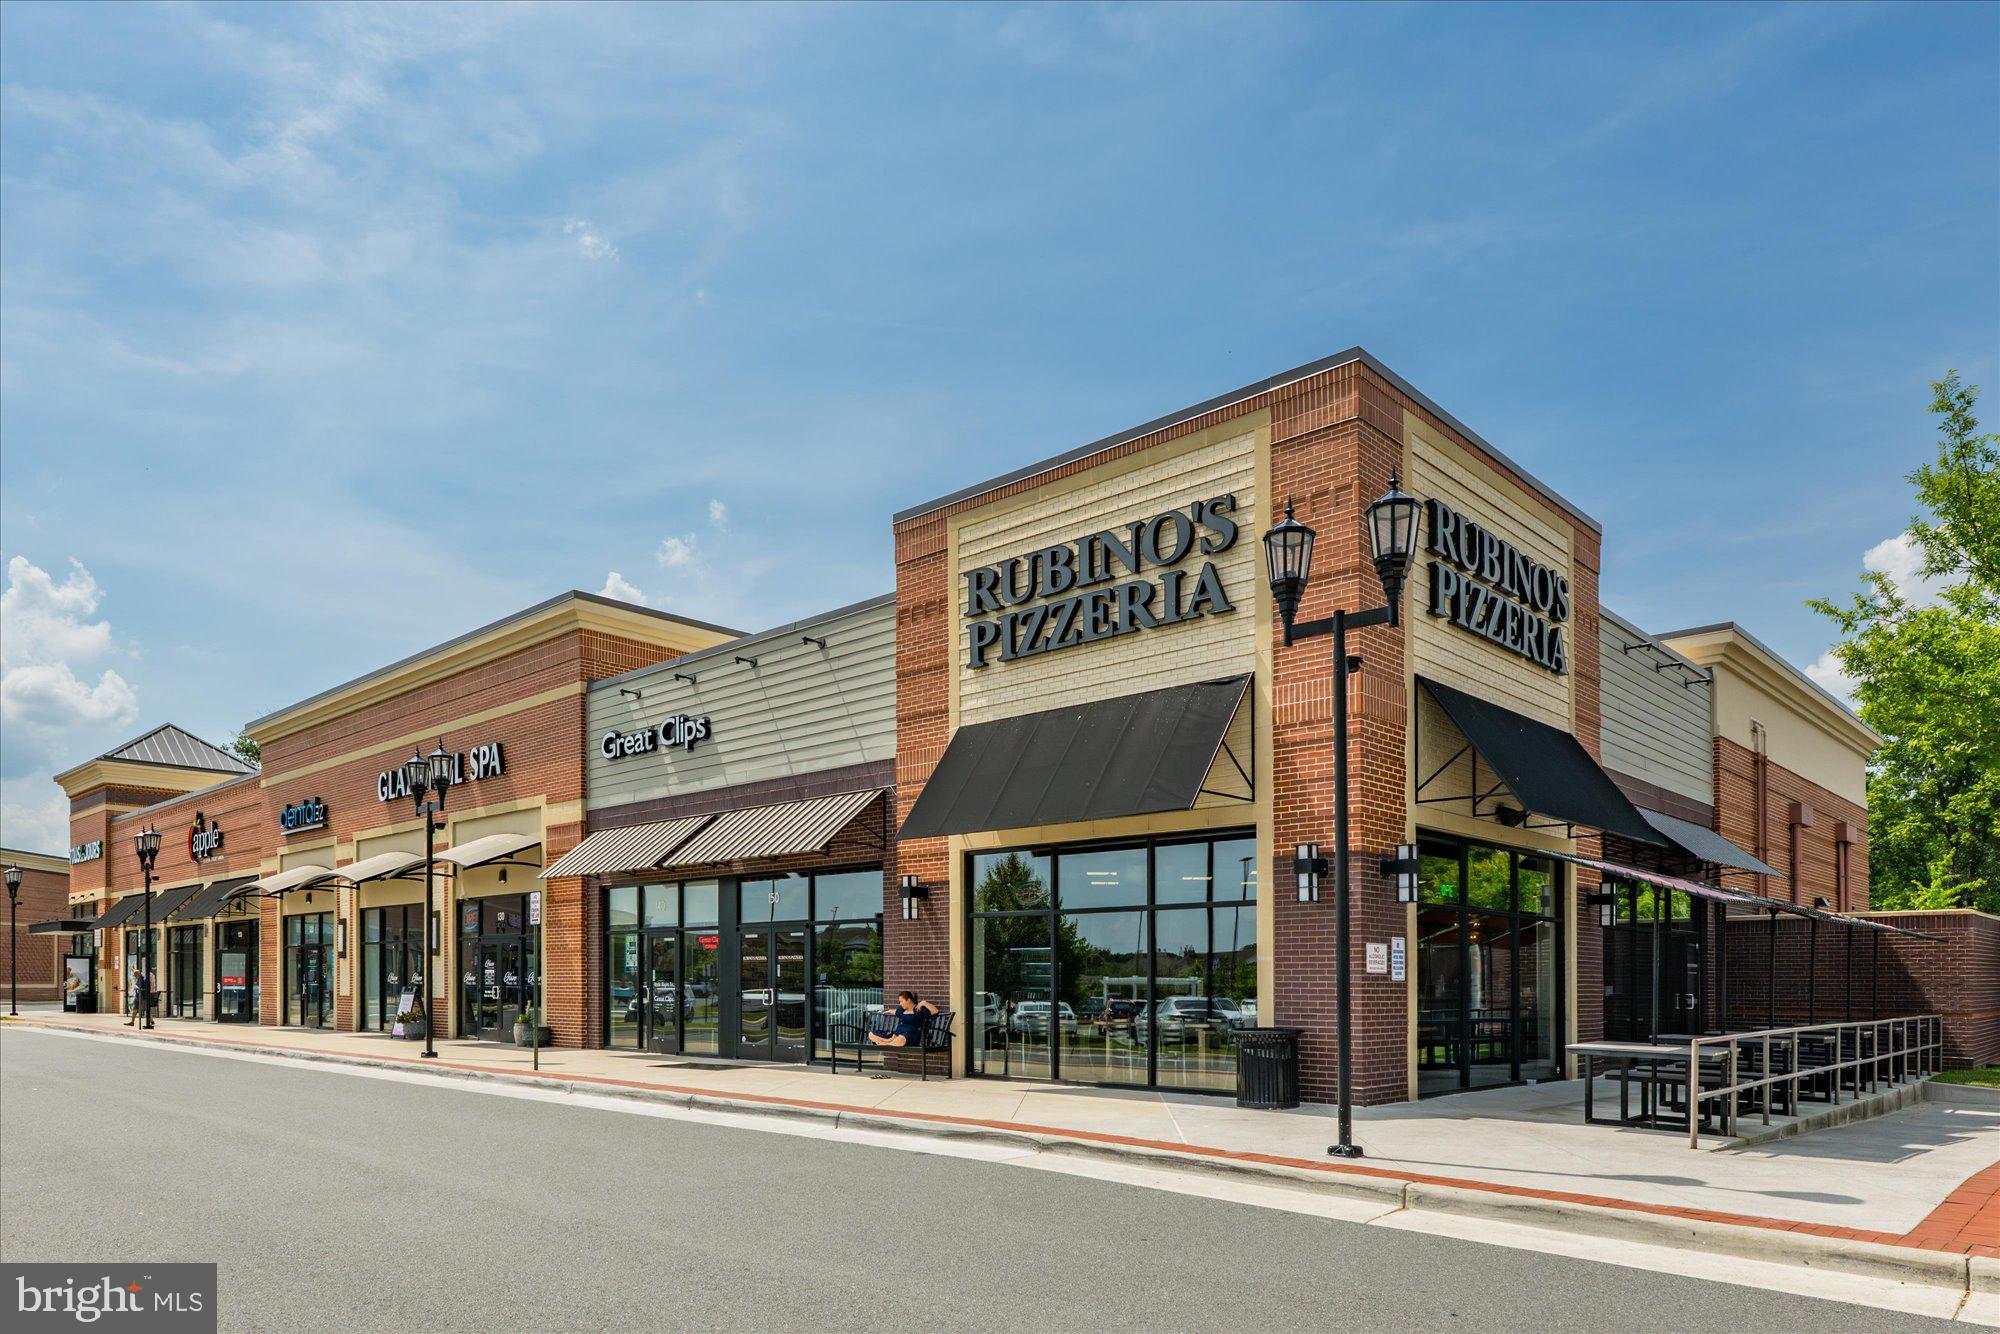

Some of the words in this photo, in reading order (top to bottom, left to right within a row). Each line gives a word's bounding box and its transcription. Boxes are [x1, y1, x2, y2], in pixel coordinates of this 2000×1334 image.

[962, 494, 1239, 618] RUBINO'S
[1425, 498, 1570, 624] RUBINO'S
[964, 562, 1236, 671] PIZZERIA
[1427, 561, 1569, 676] PIZZERIA
[601, 729, 658, 761] Great
[659, 713, 711, 753] Clips
[377, 766, 414, 802] GLA
[469, 742, 507, 782] SPA
[192, 820, 224, 859] apple
[767, 891, 780, 904] 150
[1373, 946, 1380, 954] NO
